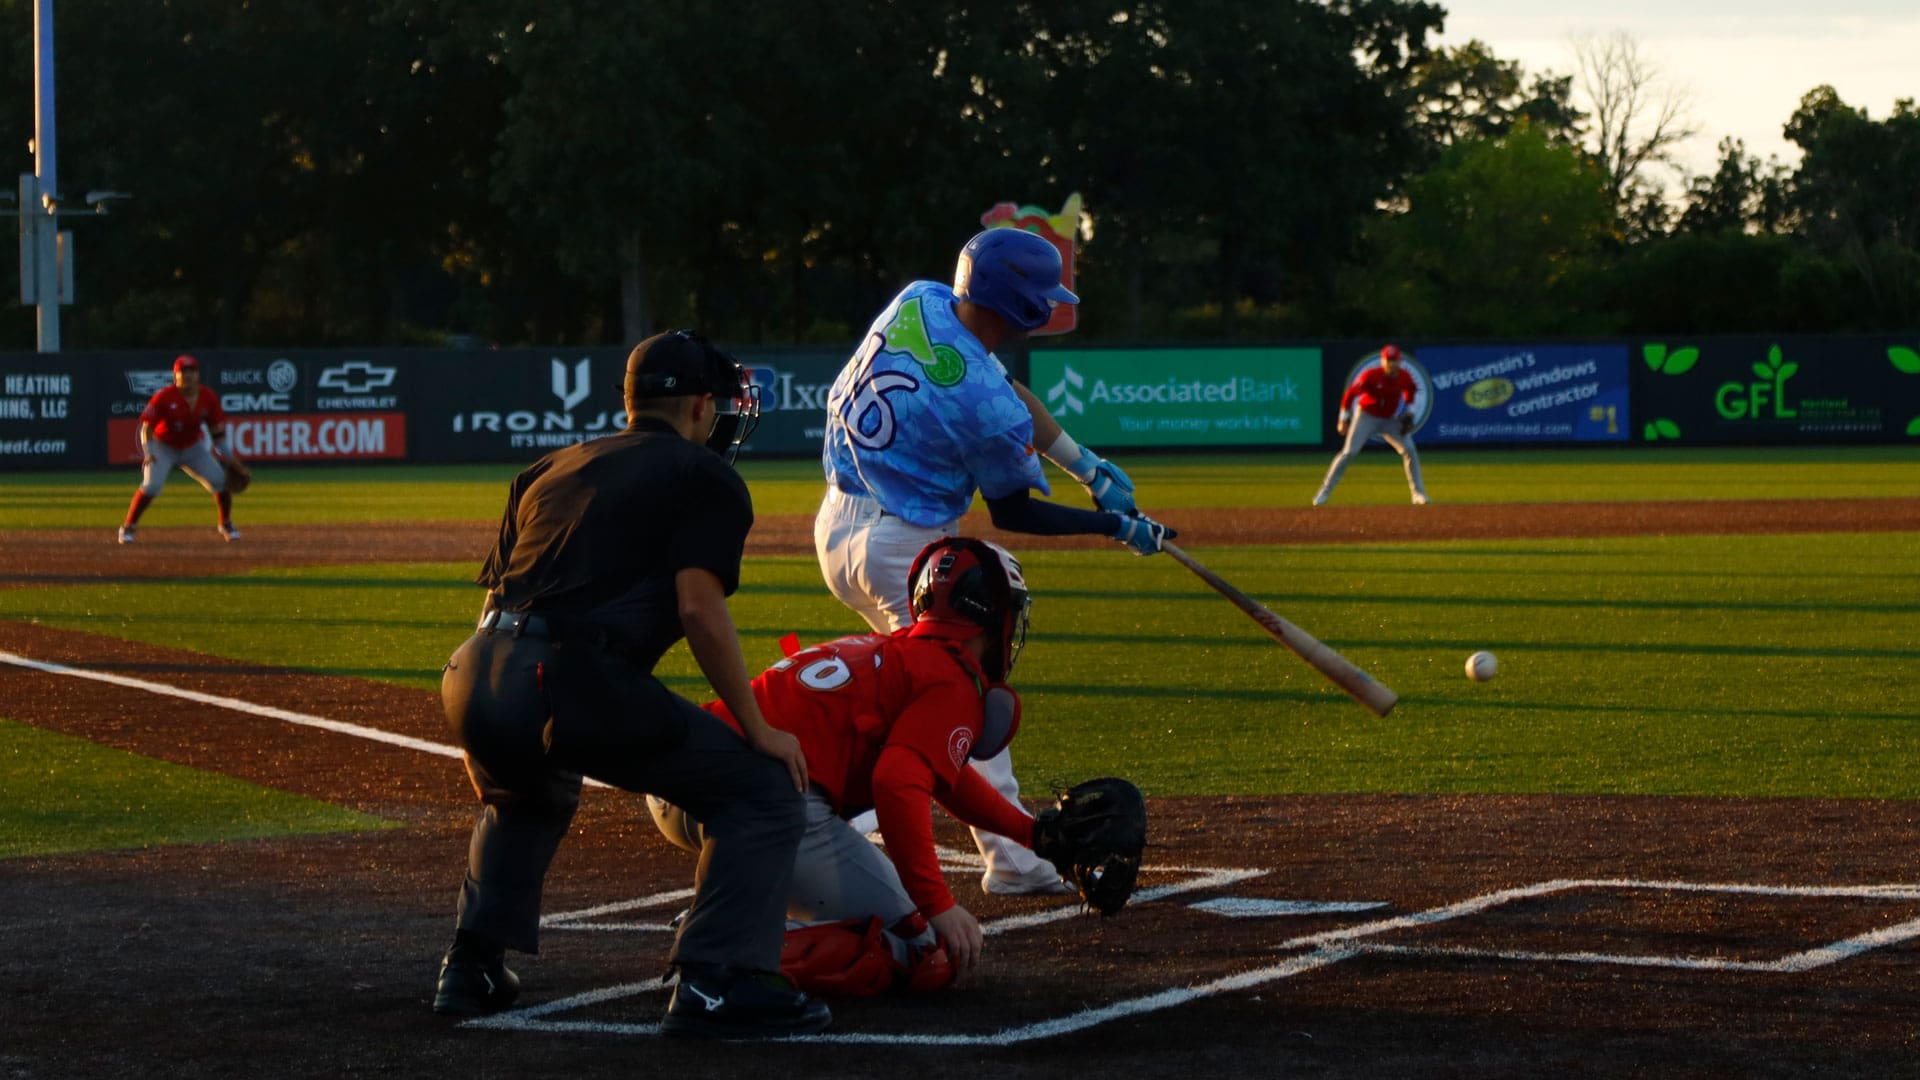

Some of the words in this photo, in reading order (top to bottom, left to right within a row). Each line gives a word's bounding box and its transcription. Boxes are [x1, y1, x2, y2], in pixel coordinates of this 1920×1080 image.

[220, 369, 263, 384] BUICK
[1432, 352, 1536, 391] Wisconsin's
[1516, 359, 1597, 391] windows
[5, 374, 71, 395] HEATING
[1090, 377, 1238, 403] Associated
[1241, 378, 1297, 402] Bank
[41, 398, 67, 419] LLC
[220, 393, 291, 412] GMC
[317, 396, 397, 409] CHEVROLET
[1507, 382, 1600, 417] contractor
[1713, 377, 1797, 421] GFL
[453, 410, 575, 433] IRON
[1120, 415, 1154, 431] Your
[1159, 418, 1209, 433] money
[1215, 416, 1260, 431] works
[510, 433, 535, 447] IT'S
